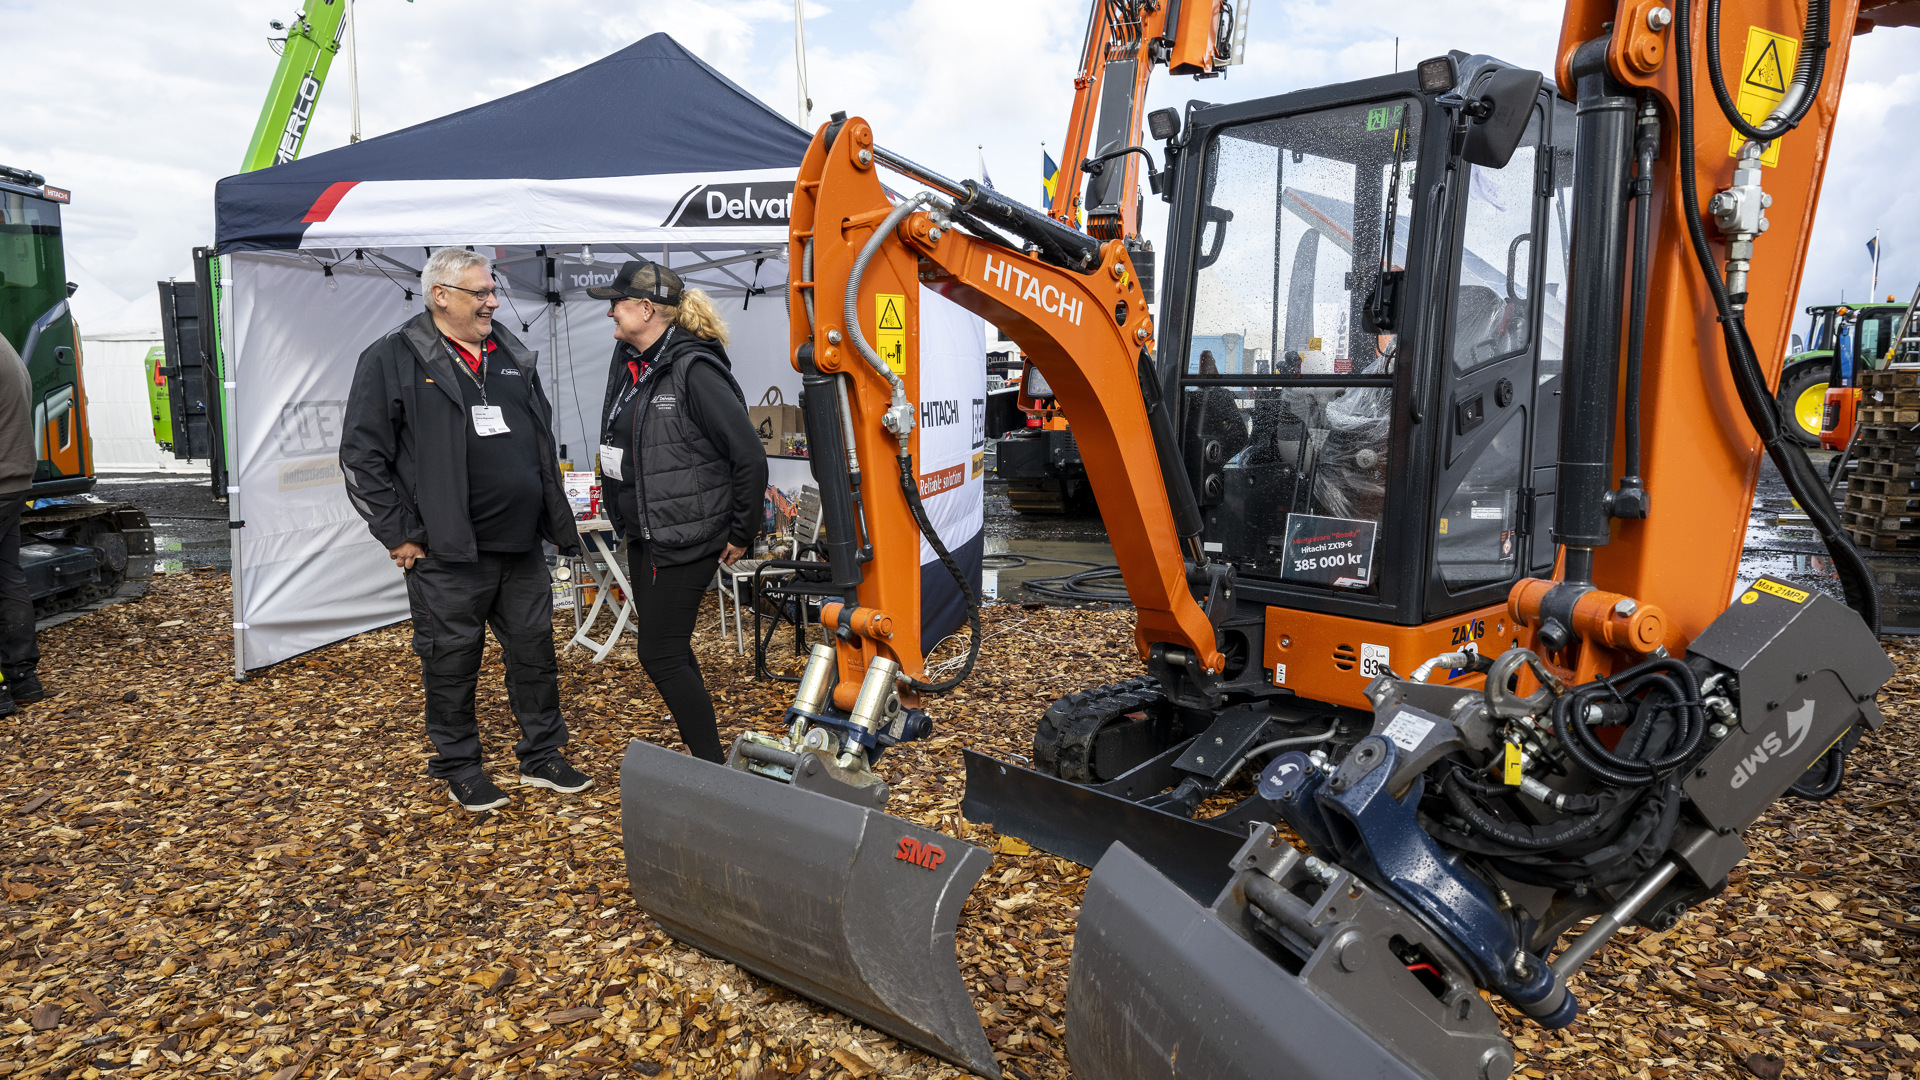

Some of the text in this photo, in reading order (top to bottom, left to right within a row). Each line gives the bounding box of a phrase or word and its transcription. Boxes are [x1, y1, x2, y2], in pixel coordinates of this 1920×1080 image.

[47, 189, 69, 200] HITACHI
[983, 253, 1084, 327] HITACHI
[920, 399, 960, 428] HITACHI
[920, 474, 942, 496] Reliable
[942, 469, 962, 489] solutions
[1301, 540, 1353, 553] Hitachi ZX19-6
[1294, 552, 1363, 571] 385 000 kr
[1756, 580, 1805, 601] Max 21MPa
[1451, 617, 1485, 646] ZAXIS
[1363, 658, 1379, 676] 93
[1730, 731, 1783, 789] SMP
[1269, 775, 1284, 787] SMP
[896, 836, 946, 870] SMP
